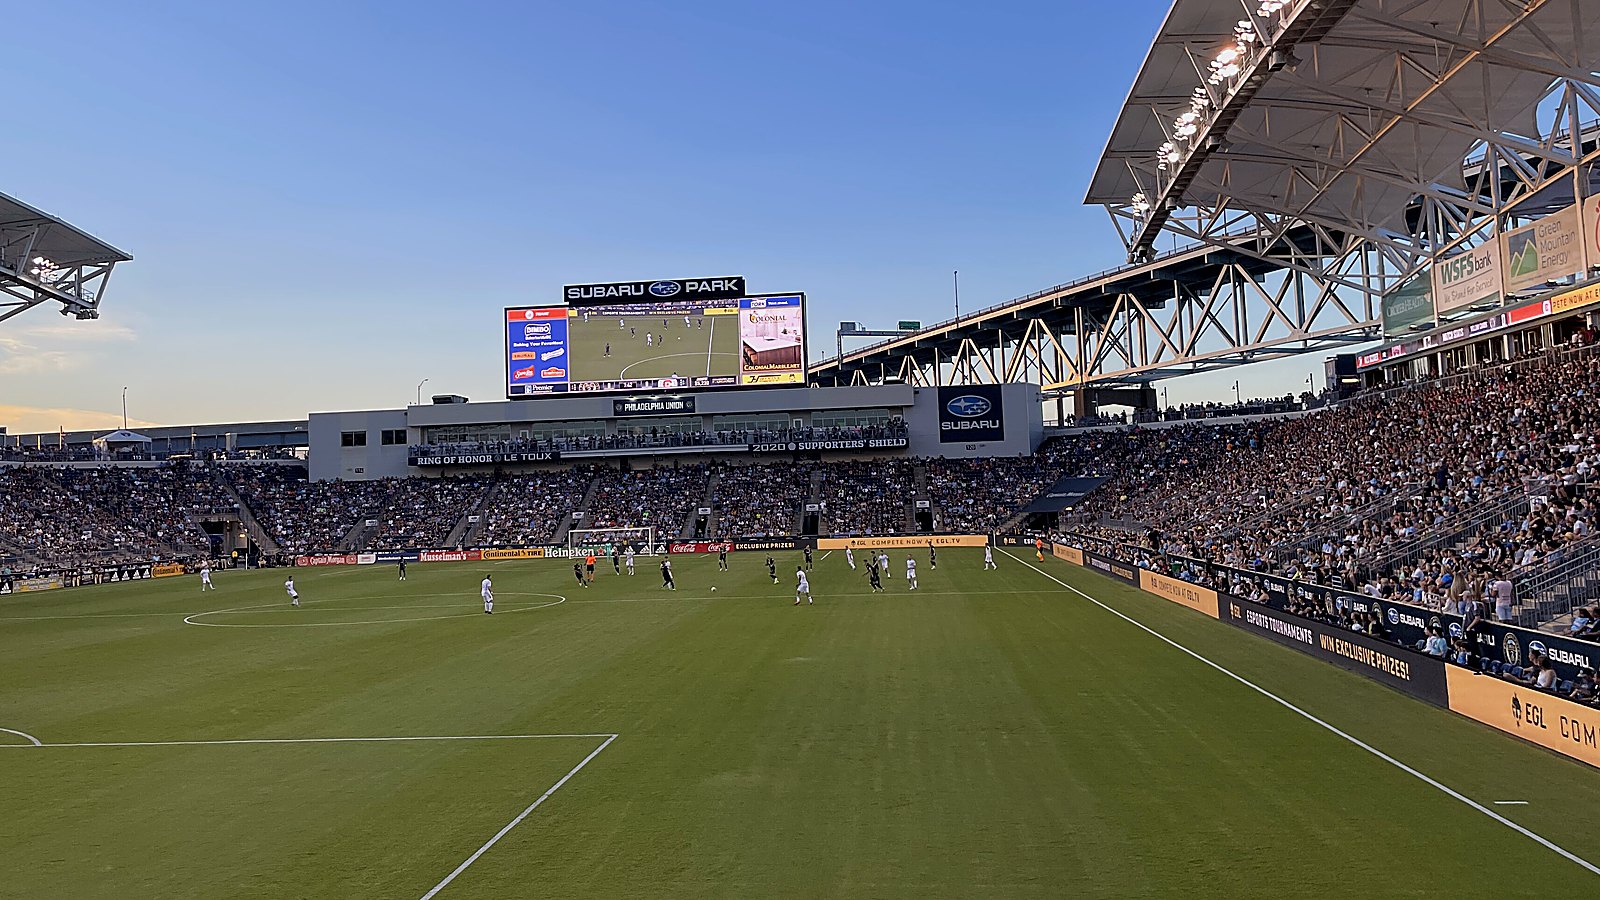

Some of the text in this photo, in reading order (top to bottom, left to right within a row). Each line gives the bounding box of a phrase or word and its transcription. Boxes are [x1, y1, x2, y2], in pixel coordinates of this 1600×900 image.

[1539, 221, 1561, 238] Green
[1540, 231, 1575, 253] Mountain
[1441, 250, 1492, 285] WSFS bank
[1541, 252, 1569, 269] Energy
[568, 279, 738, 299] SUBARU PARK
[1569, 293, 1583, 305] NOW
[624, 401, 684, 411] PHILADELPHIA UNION
[942, 419, 999, 430] SUBARU
[798, 440, 866, 450] SUPPORTERS'
[869, 438, 907, 447] SHIELD
[417, 457, 441, 465] RING
[443, 456, 456, 464] OF
[458, 454, 492, 464] HONOR
[420, 552, 467, 561] Musselman's
[483, 549, 520, 559] Continental
[544, 547, 594, 557] Heineken
[1400, 613, 1425, 629] SUBARU
[1246, 609, 1269, 629] ESPORTS
[1268, 617, 1313, 645] TOURNAMENTS
[1319, 633, 1335, 652] WIN
[1335, 638, 1376, 667] EXCLUSIVE
[1376, 652, 1410, 681] PRIZES!
[1549, 647, 1589, 669] SUBARU
[1525, 702, 1600, 749] EGL COM
